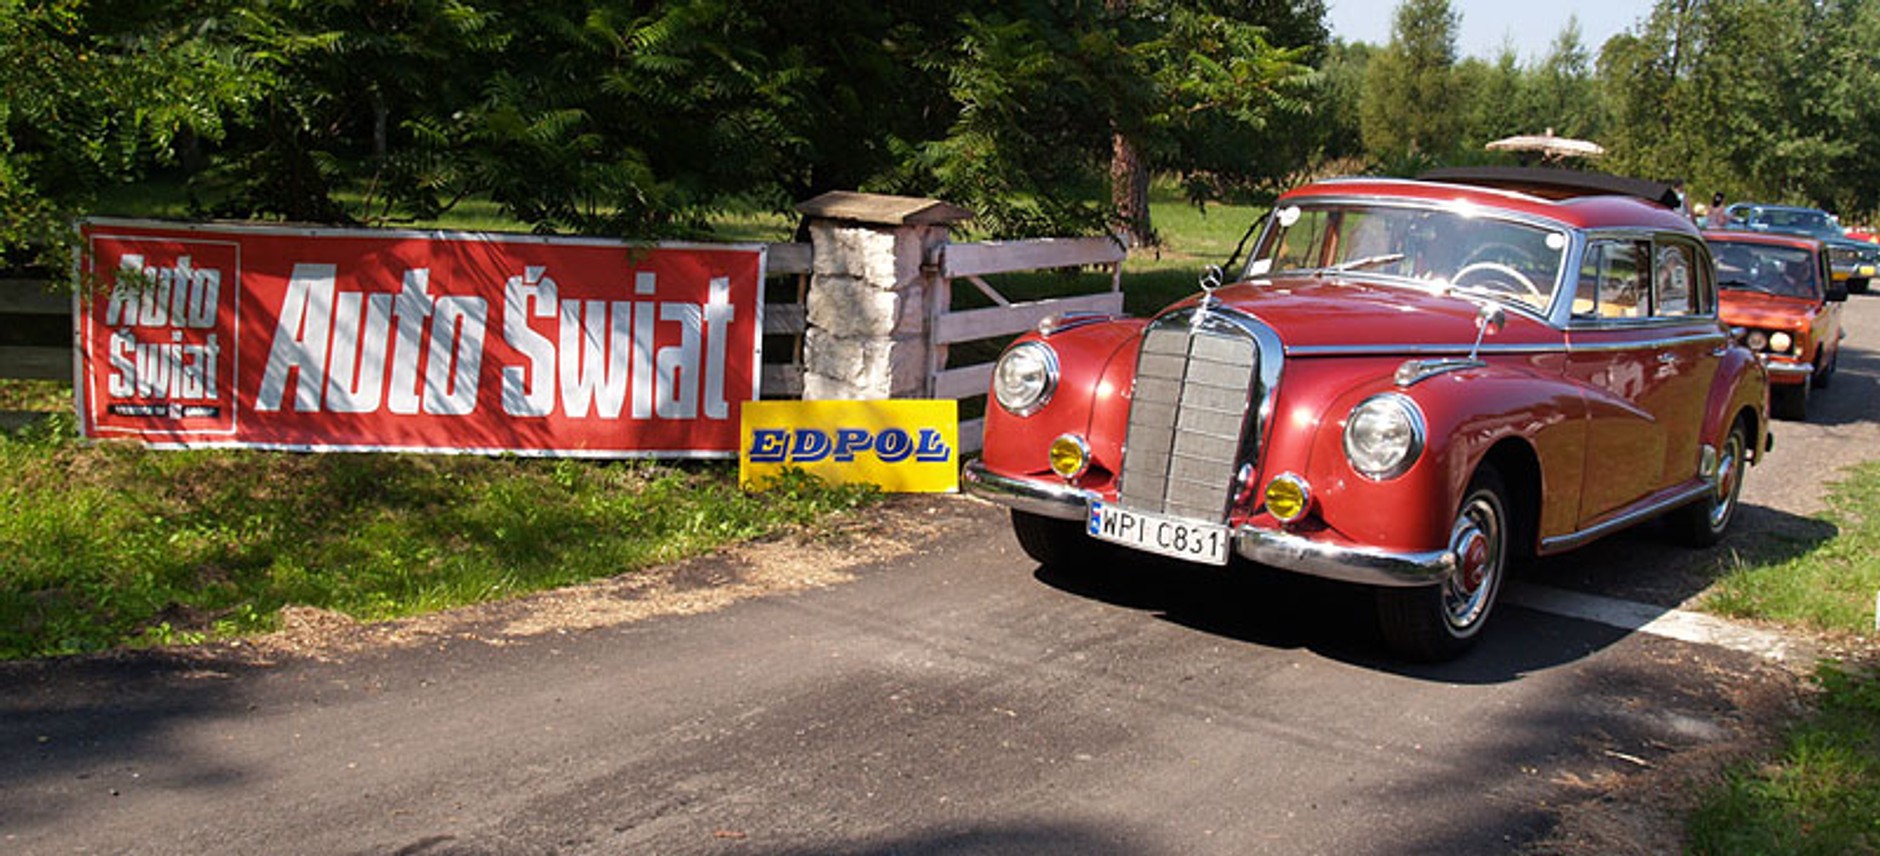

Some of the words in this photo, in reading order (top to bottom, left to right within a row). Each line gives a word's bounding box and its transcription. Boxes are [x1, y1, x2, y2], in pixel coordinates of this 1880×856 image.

[106, 254, 221, 327] Auto
[108, 328, 220, 399] Świat
[254, 263, 488, 415] Auto
[502, 266, 735, 420] Świat
[749, 429, 951, 462] EDPOL
[1103, 509, 1146, 542] WPI
[1156, 521, 1218, 557] C831
